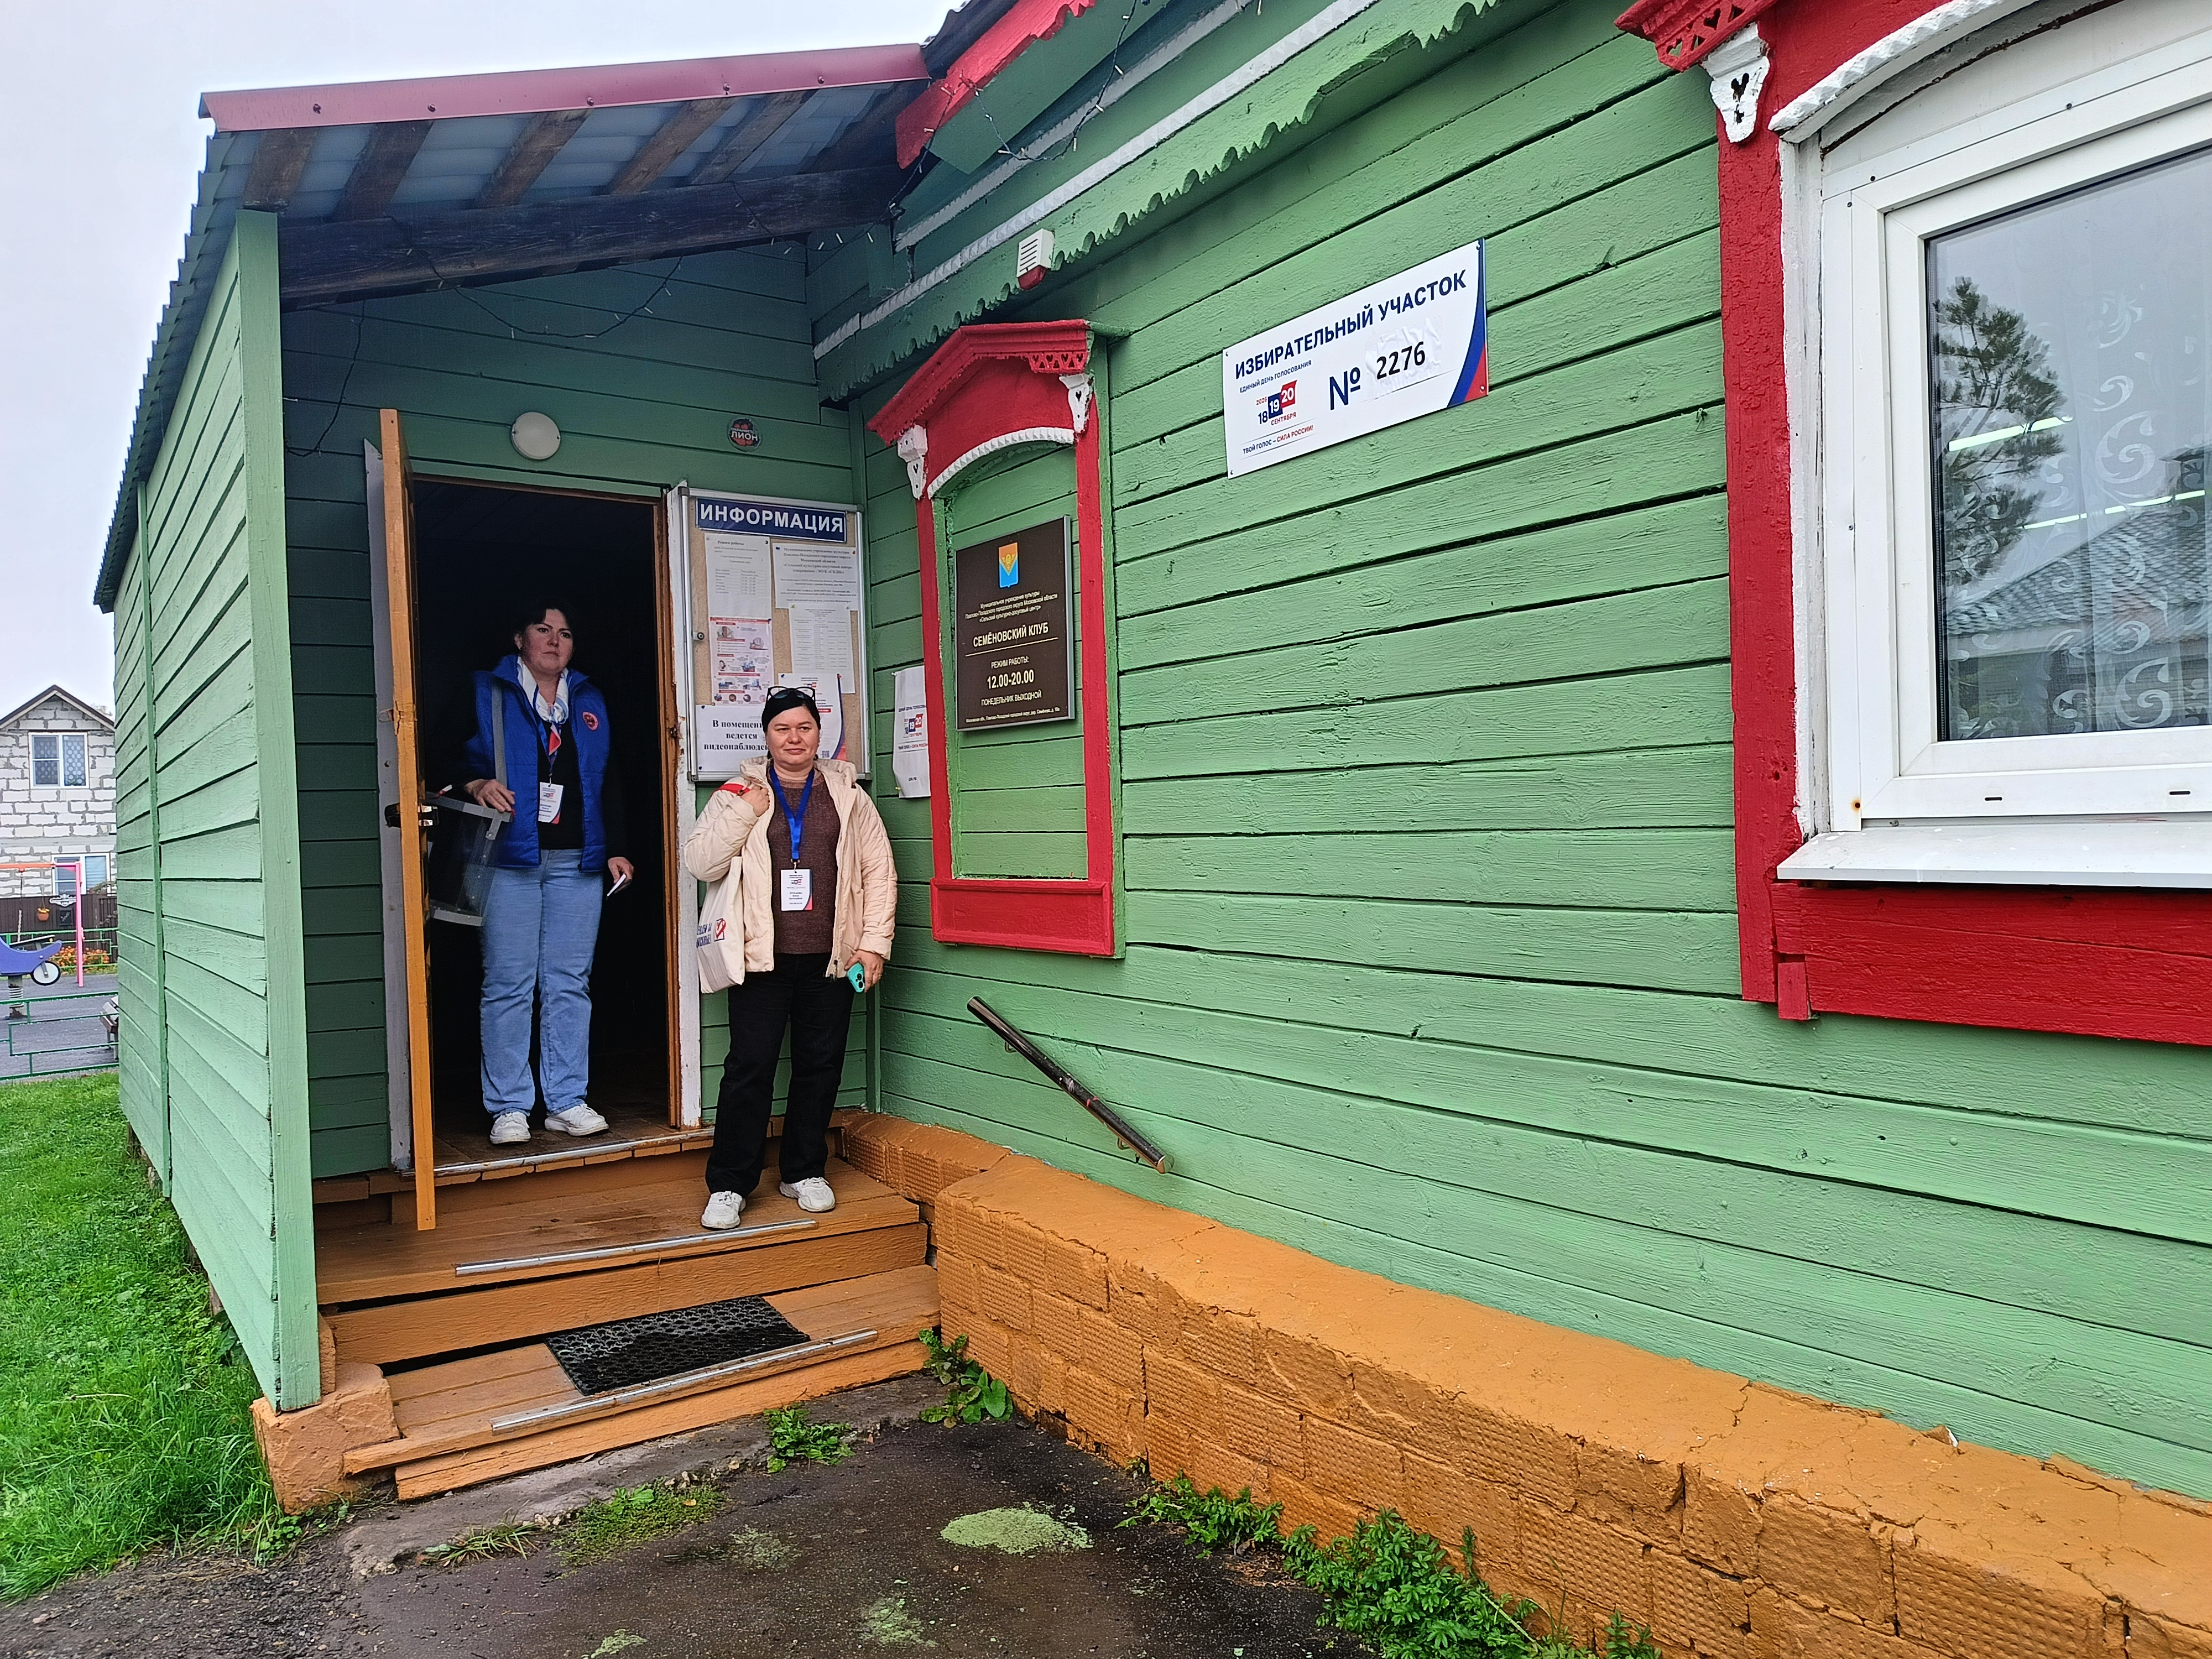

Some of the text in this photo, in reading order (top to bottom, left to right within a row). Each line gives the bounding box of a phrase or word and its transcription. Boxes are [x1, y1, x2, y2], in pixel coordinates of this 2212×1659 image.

[1236, 269, 1467, 379] ИЗБИРАТЕЛЬНЫЙ УЧАСТОК
[1239, 360, 1312, 393] ЕДИНЫЙ ДЕНЬ ГОЛОСОВАНИЯ
[1329, 341, 1425, 410] № 2276
[1256, 397, 1267, 405] 2026
[1258, 387, 1294, 424] 18 19 20
[1271, 412, 1296, 426] СЕНТЯБРЯ
[731, 431, 758, 441] ЛИОН
[1243, 444, 1255, 454] ТВОЙ
[1256, 439, 1272, 450] ГОЛОС
[1277, 433, 1291, 442] СИЛА
[1291, 425, 1313, 437] РОССИИ!
[701, 503, 843, 533] ИНФОРМАЦИЯ
[973, 622, 1048, 647] СЕМЁНОВСКИЙ КЛУБ
[991, 656, 1029, 669] РЕЖИМ РАБОТЫ:
[987, 669, 1034, 689] 12.00-20.00
[981, 690, 1042, 706] ПОНЕДЕЛЬНИК ВЫХОДНОЙ
[909, 722, 915, 730] 19
